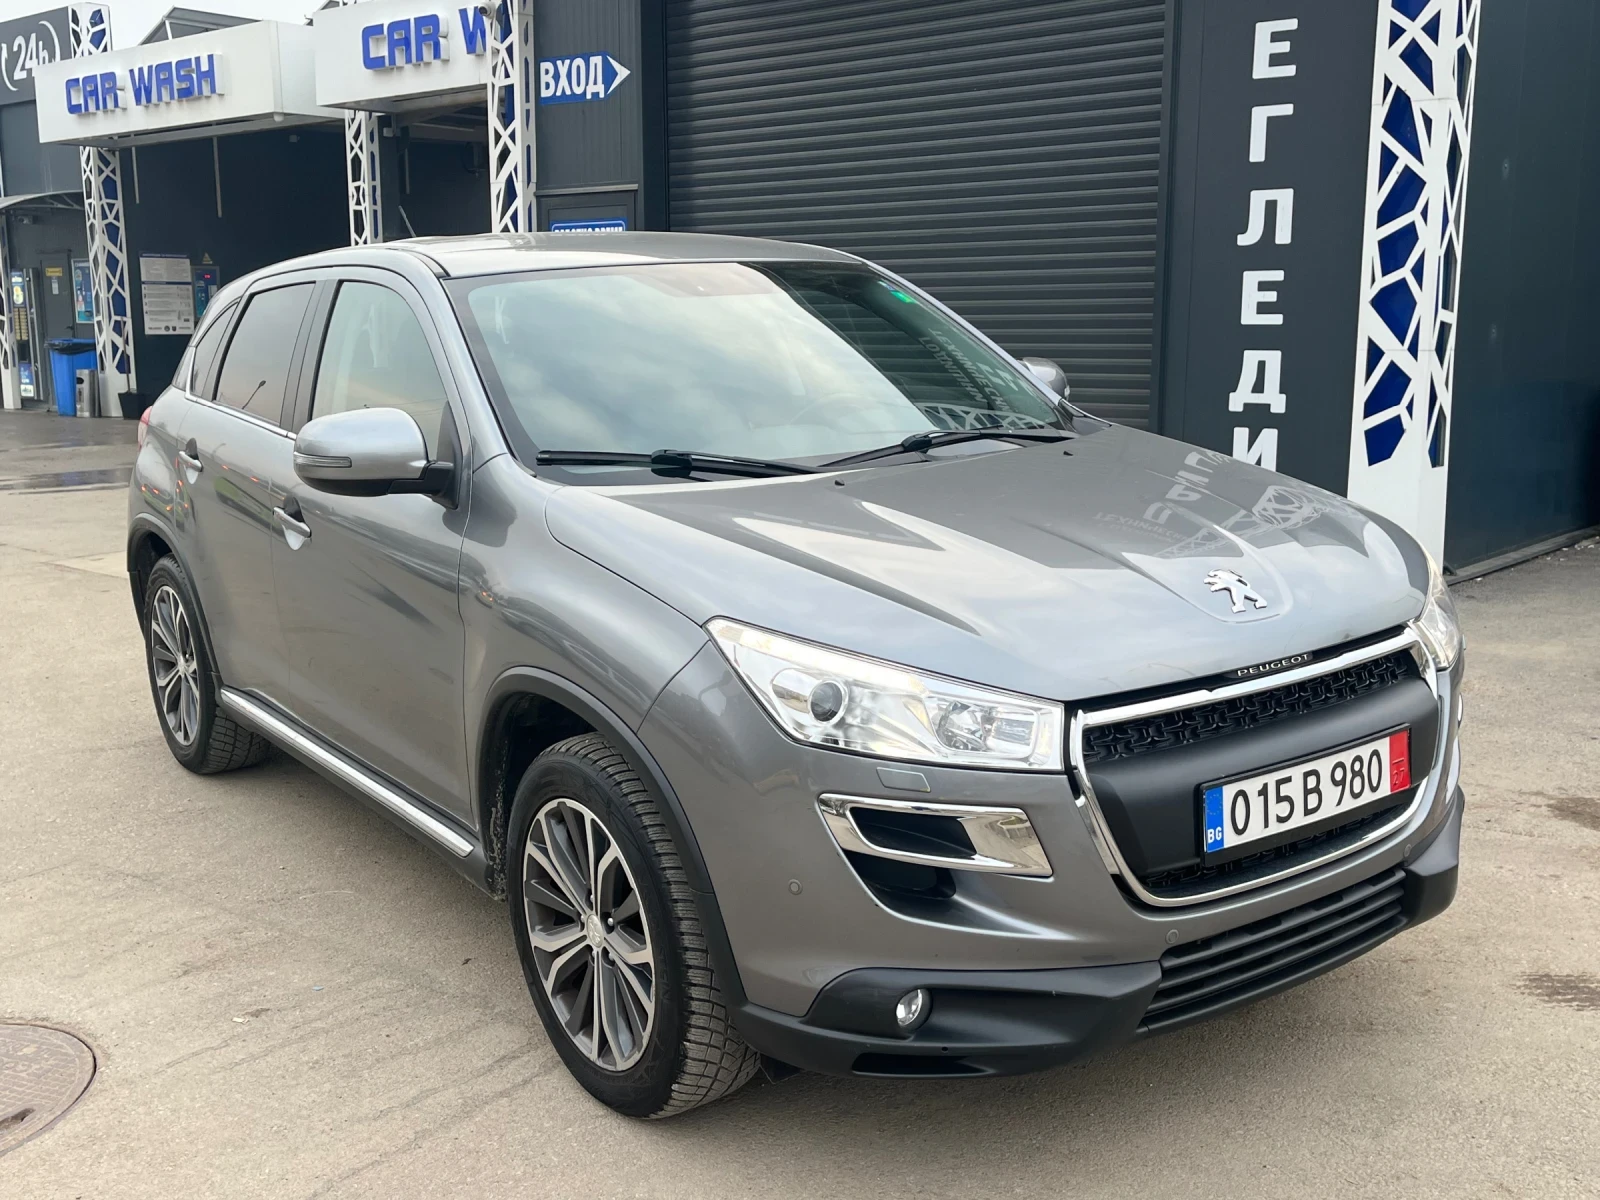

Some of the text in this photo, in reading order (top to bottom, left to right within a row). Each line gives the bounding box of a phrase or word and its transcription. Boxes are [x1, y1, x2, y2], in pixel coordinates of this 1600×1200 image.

[361, 14, 441, 70] CAR
[65, 53, 218, 115] CAR WASH
[539, 55, 605, 99] ВХОД
[1237, 653, 1310, 677] PEUGEOT
[1207, 826, 1223, 844] BG
